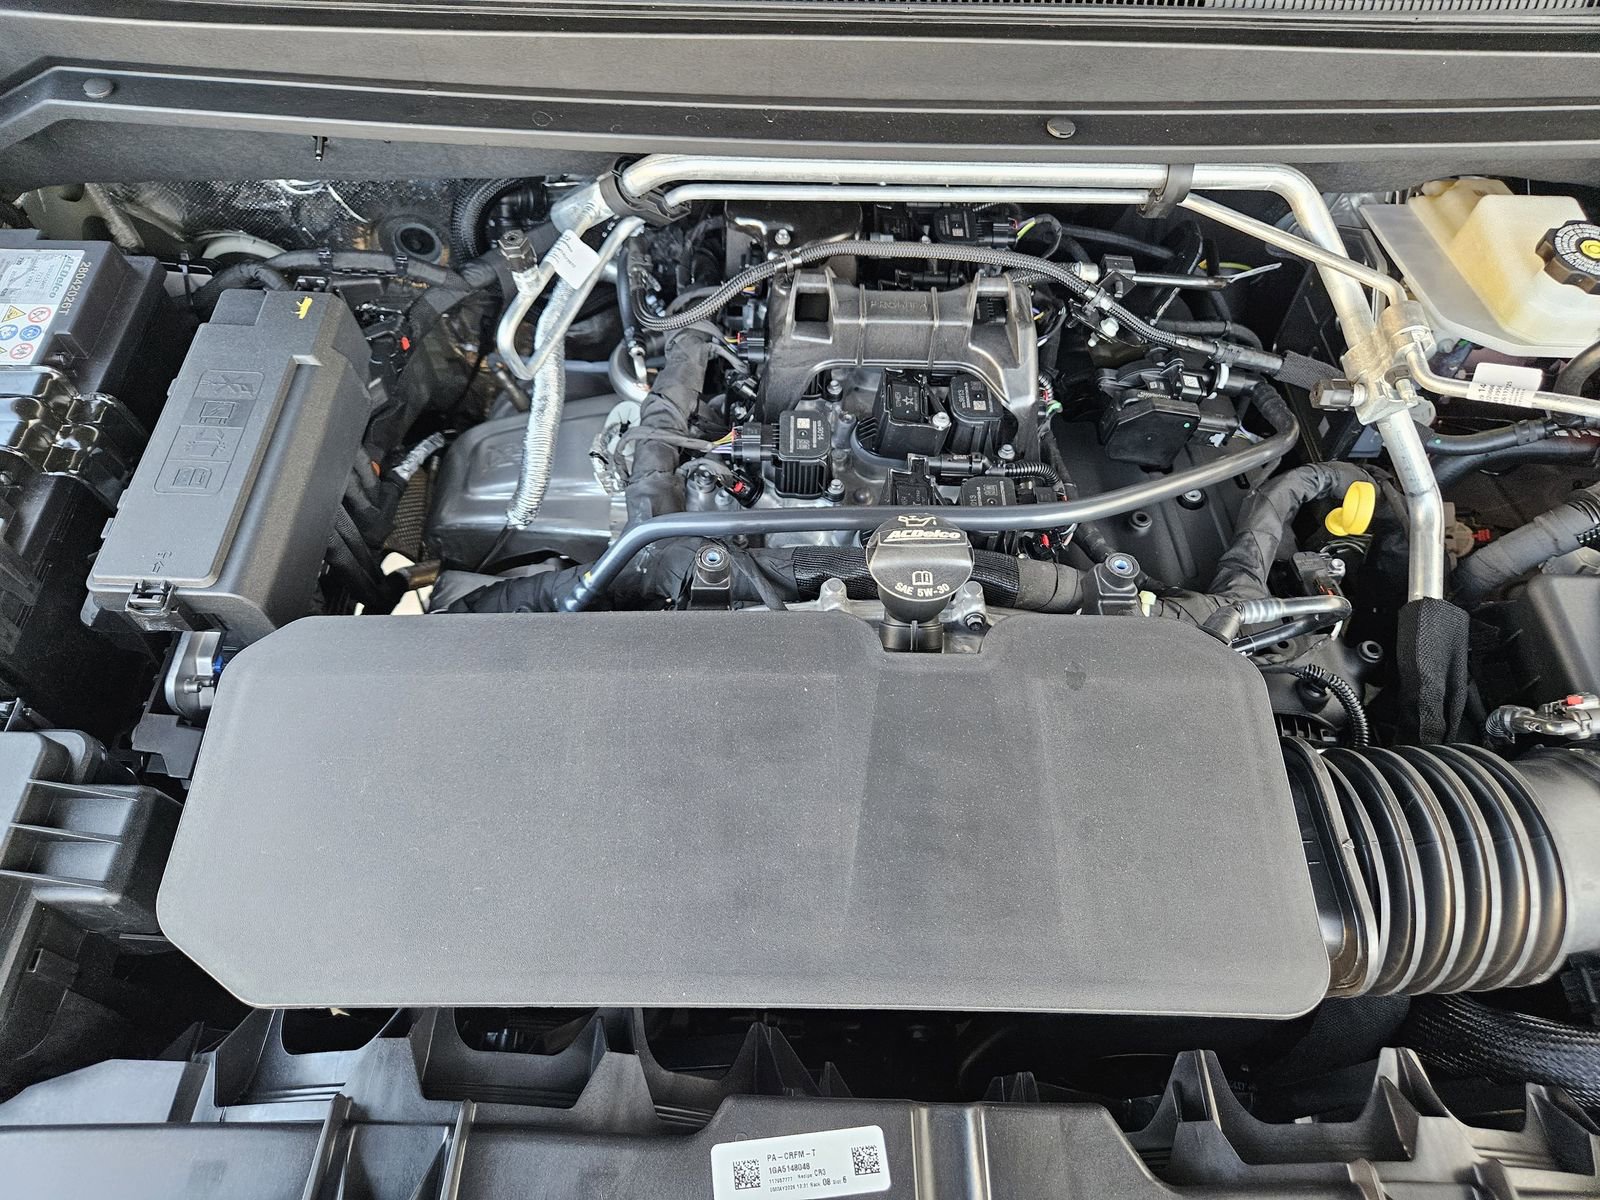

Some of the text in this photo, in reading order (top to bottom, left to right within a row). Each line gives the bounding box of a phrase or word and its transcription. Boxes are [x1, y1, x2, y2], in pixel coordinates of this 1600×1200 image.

[49, 254, 74, 299] ACDelco
[58, 261, 92, 315] 28042026T
[885, 529, 961, 540] ACDelco
[894, 582, 950, 597] SAE 5W-30
[813, 1168, 826, 1176] CR3
[822, 1177, 831, 1185] 08
[842, 1175, 847, 1183] 6
